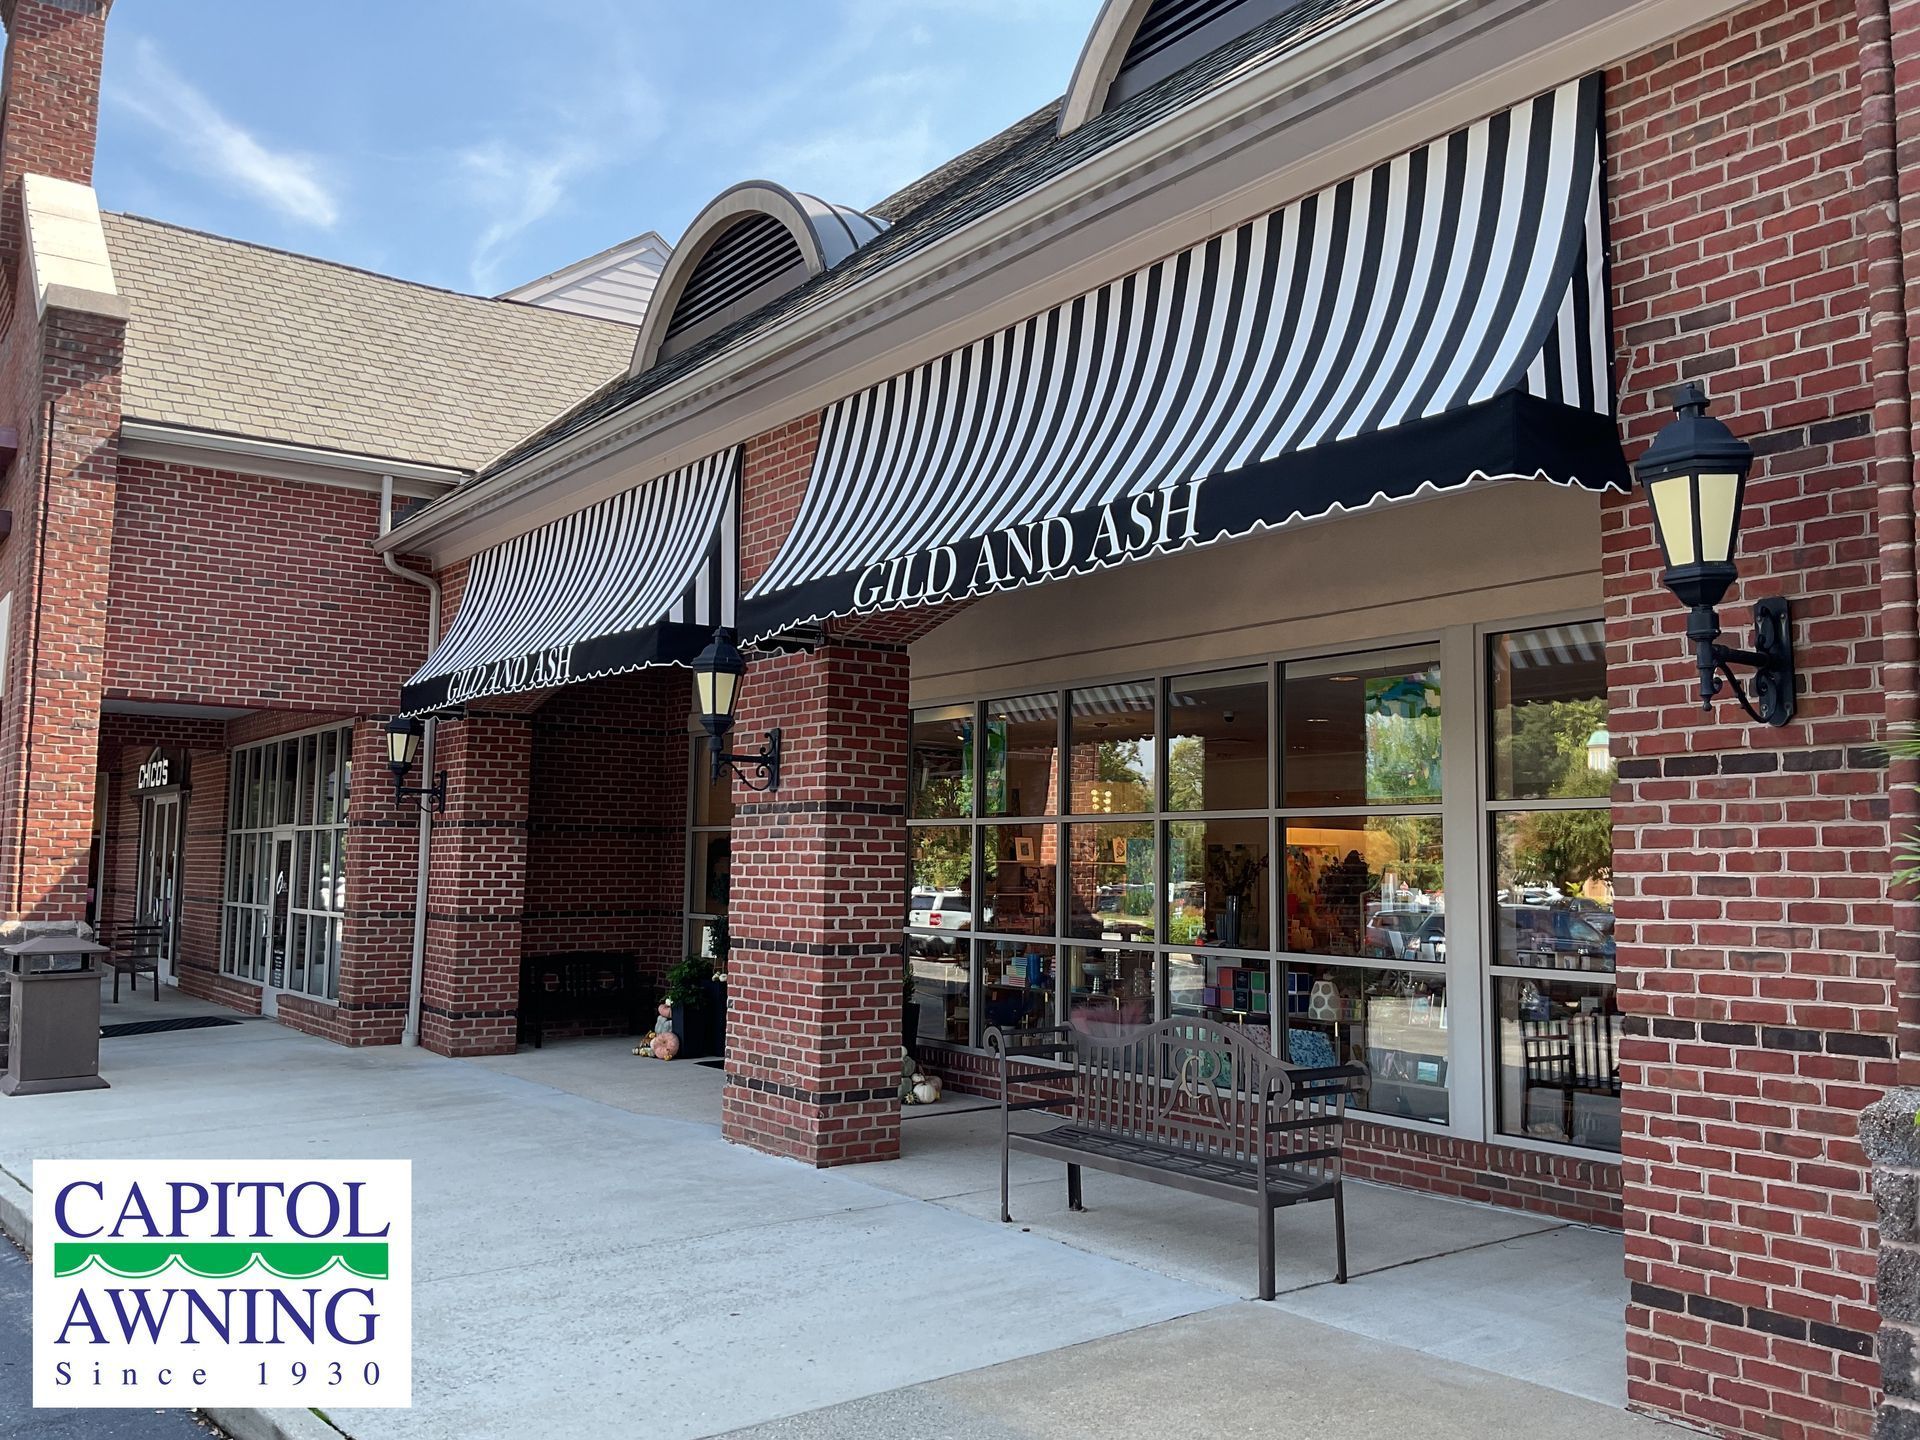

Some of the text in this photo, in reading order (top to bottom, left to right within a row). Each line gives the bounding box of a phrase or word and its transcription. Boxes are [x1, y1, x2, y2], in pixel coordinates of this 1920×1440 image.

[854, 479, 1207, 607] GILD AND ASH
[447, 644, 574, 700] GILD AND ASH
